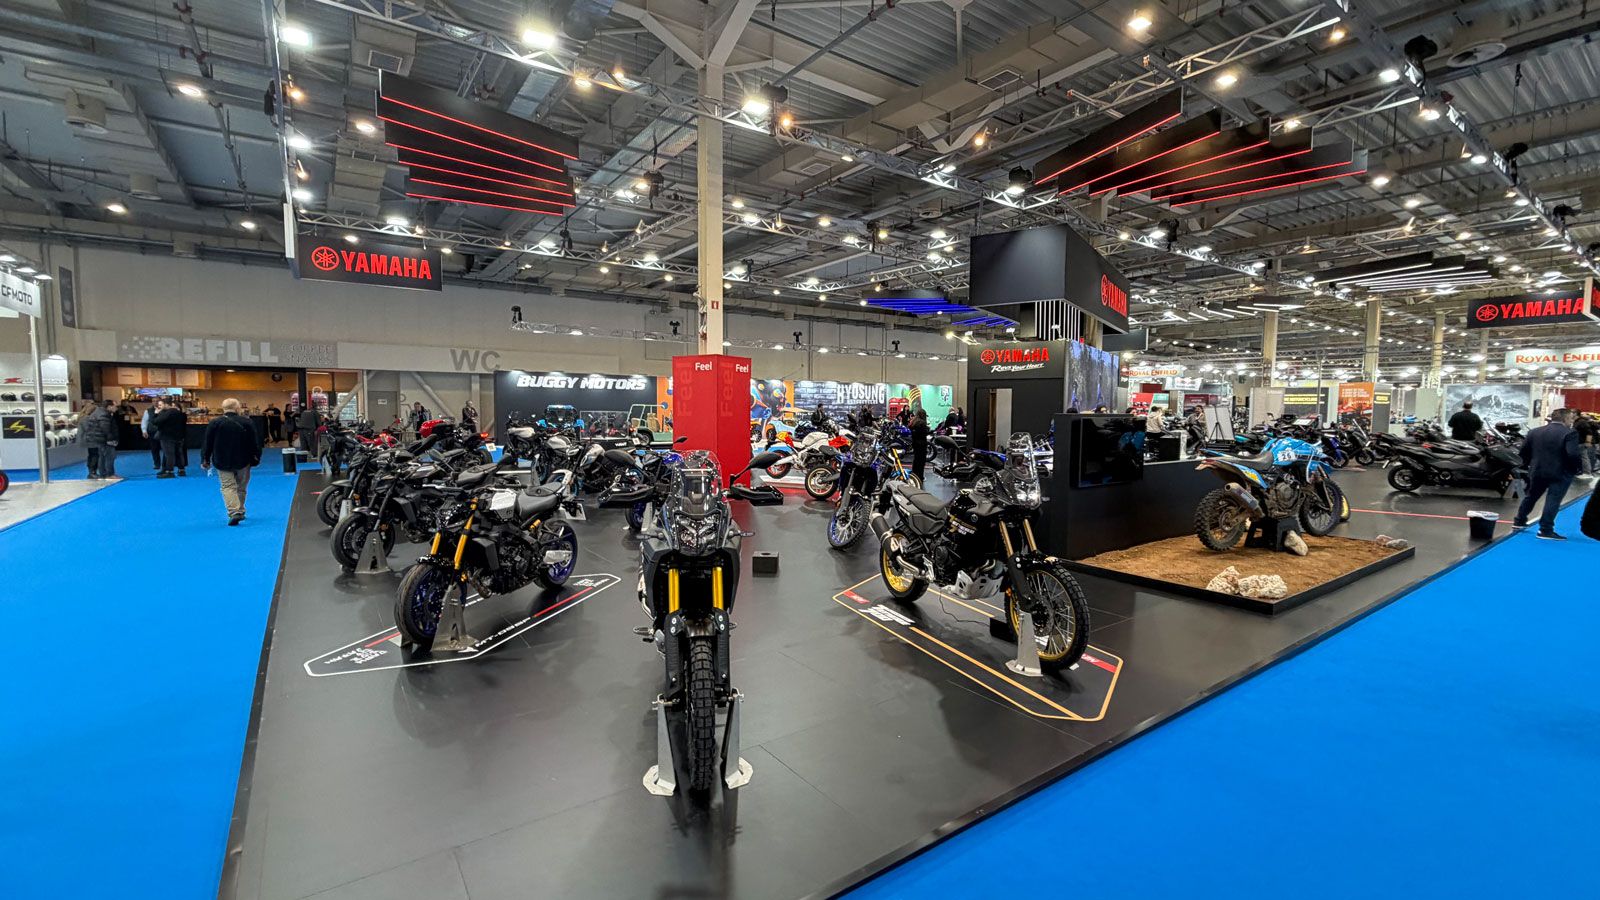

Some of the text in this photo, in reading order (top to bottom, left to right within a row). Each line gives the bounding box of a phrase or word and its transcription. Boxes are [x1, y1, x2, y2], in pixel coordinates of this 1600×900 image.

[341, 250, 432, 280] YAMAHA
[1, 284, 33, 306] CFMOTO
[1500, 297, 1585, 319] YAMAHA
[160, 337, 278, 363] REFILL
[450, 348, 501, 372] WC
[995, 347, 1050, 363] YAMAHA
[1516, 354, 1560, 363] ROYAL
[695, 361, 713, 371] Feel
[735, 363, 749, 373] Feel
[517, 375, 647, 391] BUGGY MOTORS
[676, 362, 692, 417] Feel
[719, 362, 734, 417] Feel
[836, 384, 885, 404] HYOSUNG
